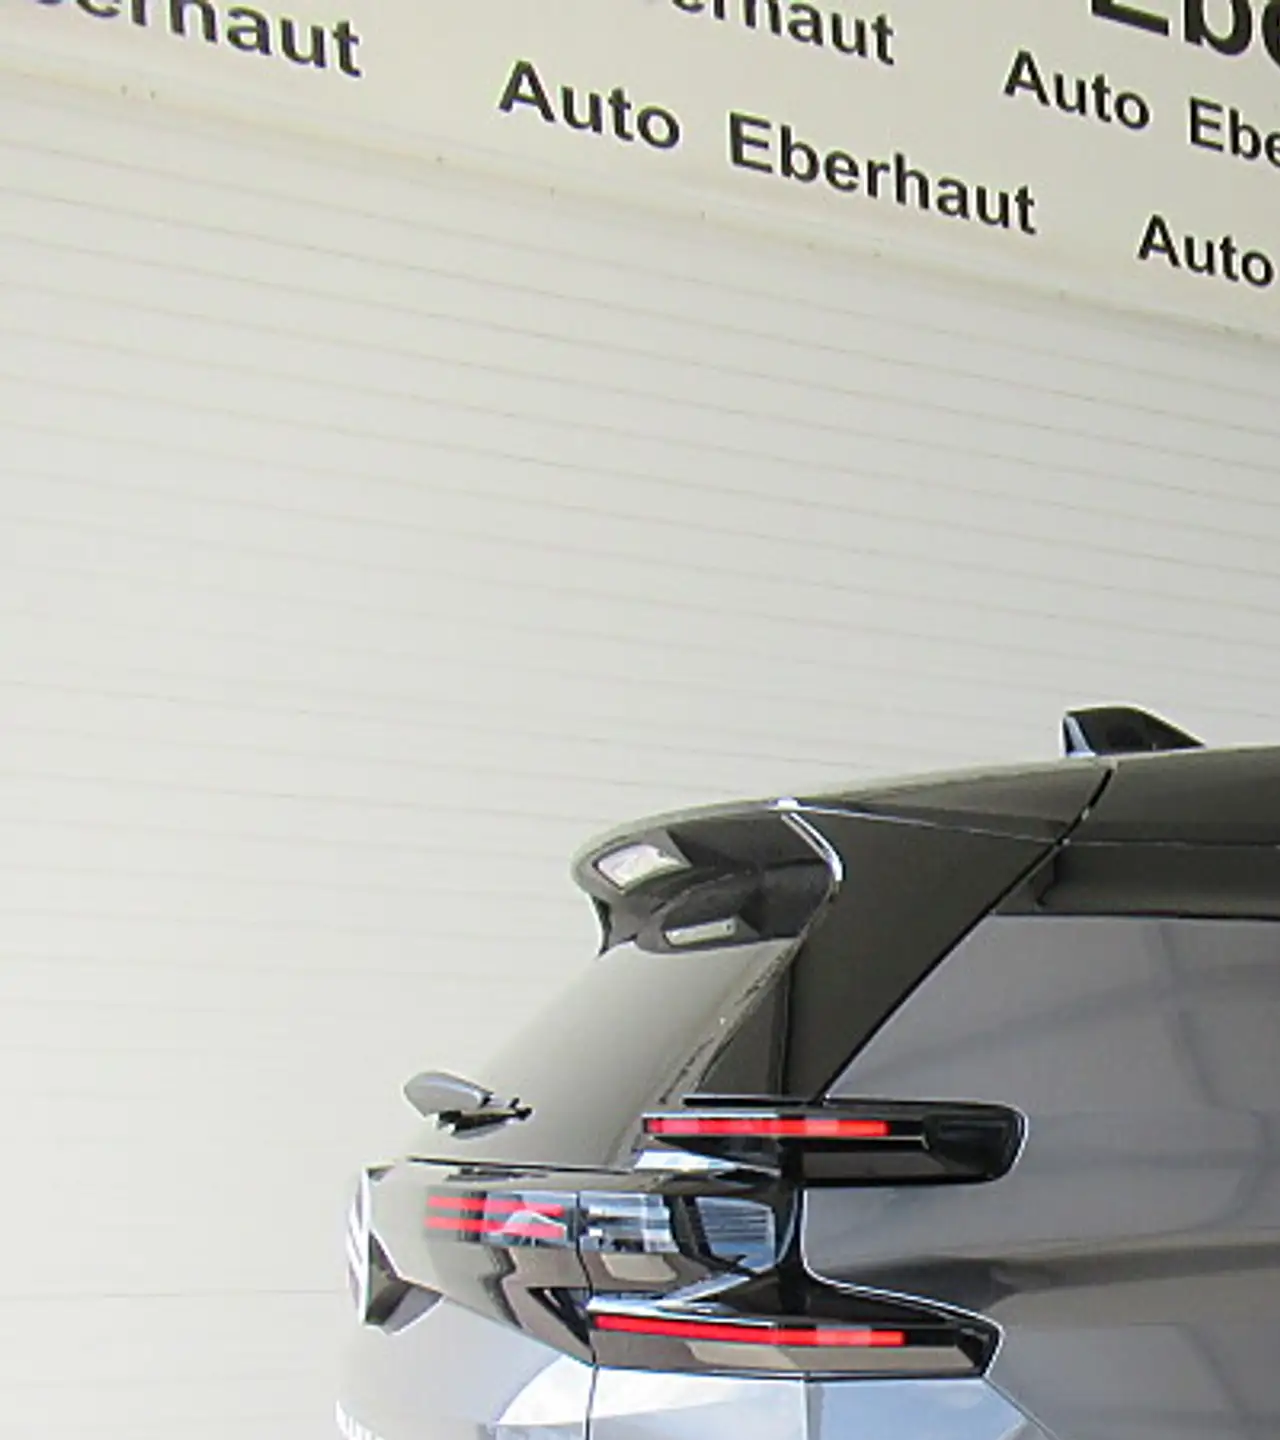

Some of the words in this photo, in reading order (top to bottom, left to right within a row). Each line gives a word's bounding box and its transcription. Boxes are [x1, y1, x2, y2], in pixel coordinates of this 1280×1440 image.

[1003, 49, 1151, 131] Auto
[498, 60, 681, 150] Auto
[728, 111, 1037, 236] Eberhaut
[1137, 213, 1275, 288] Auto
